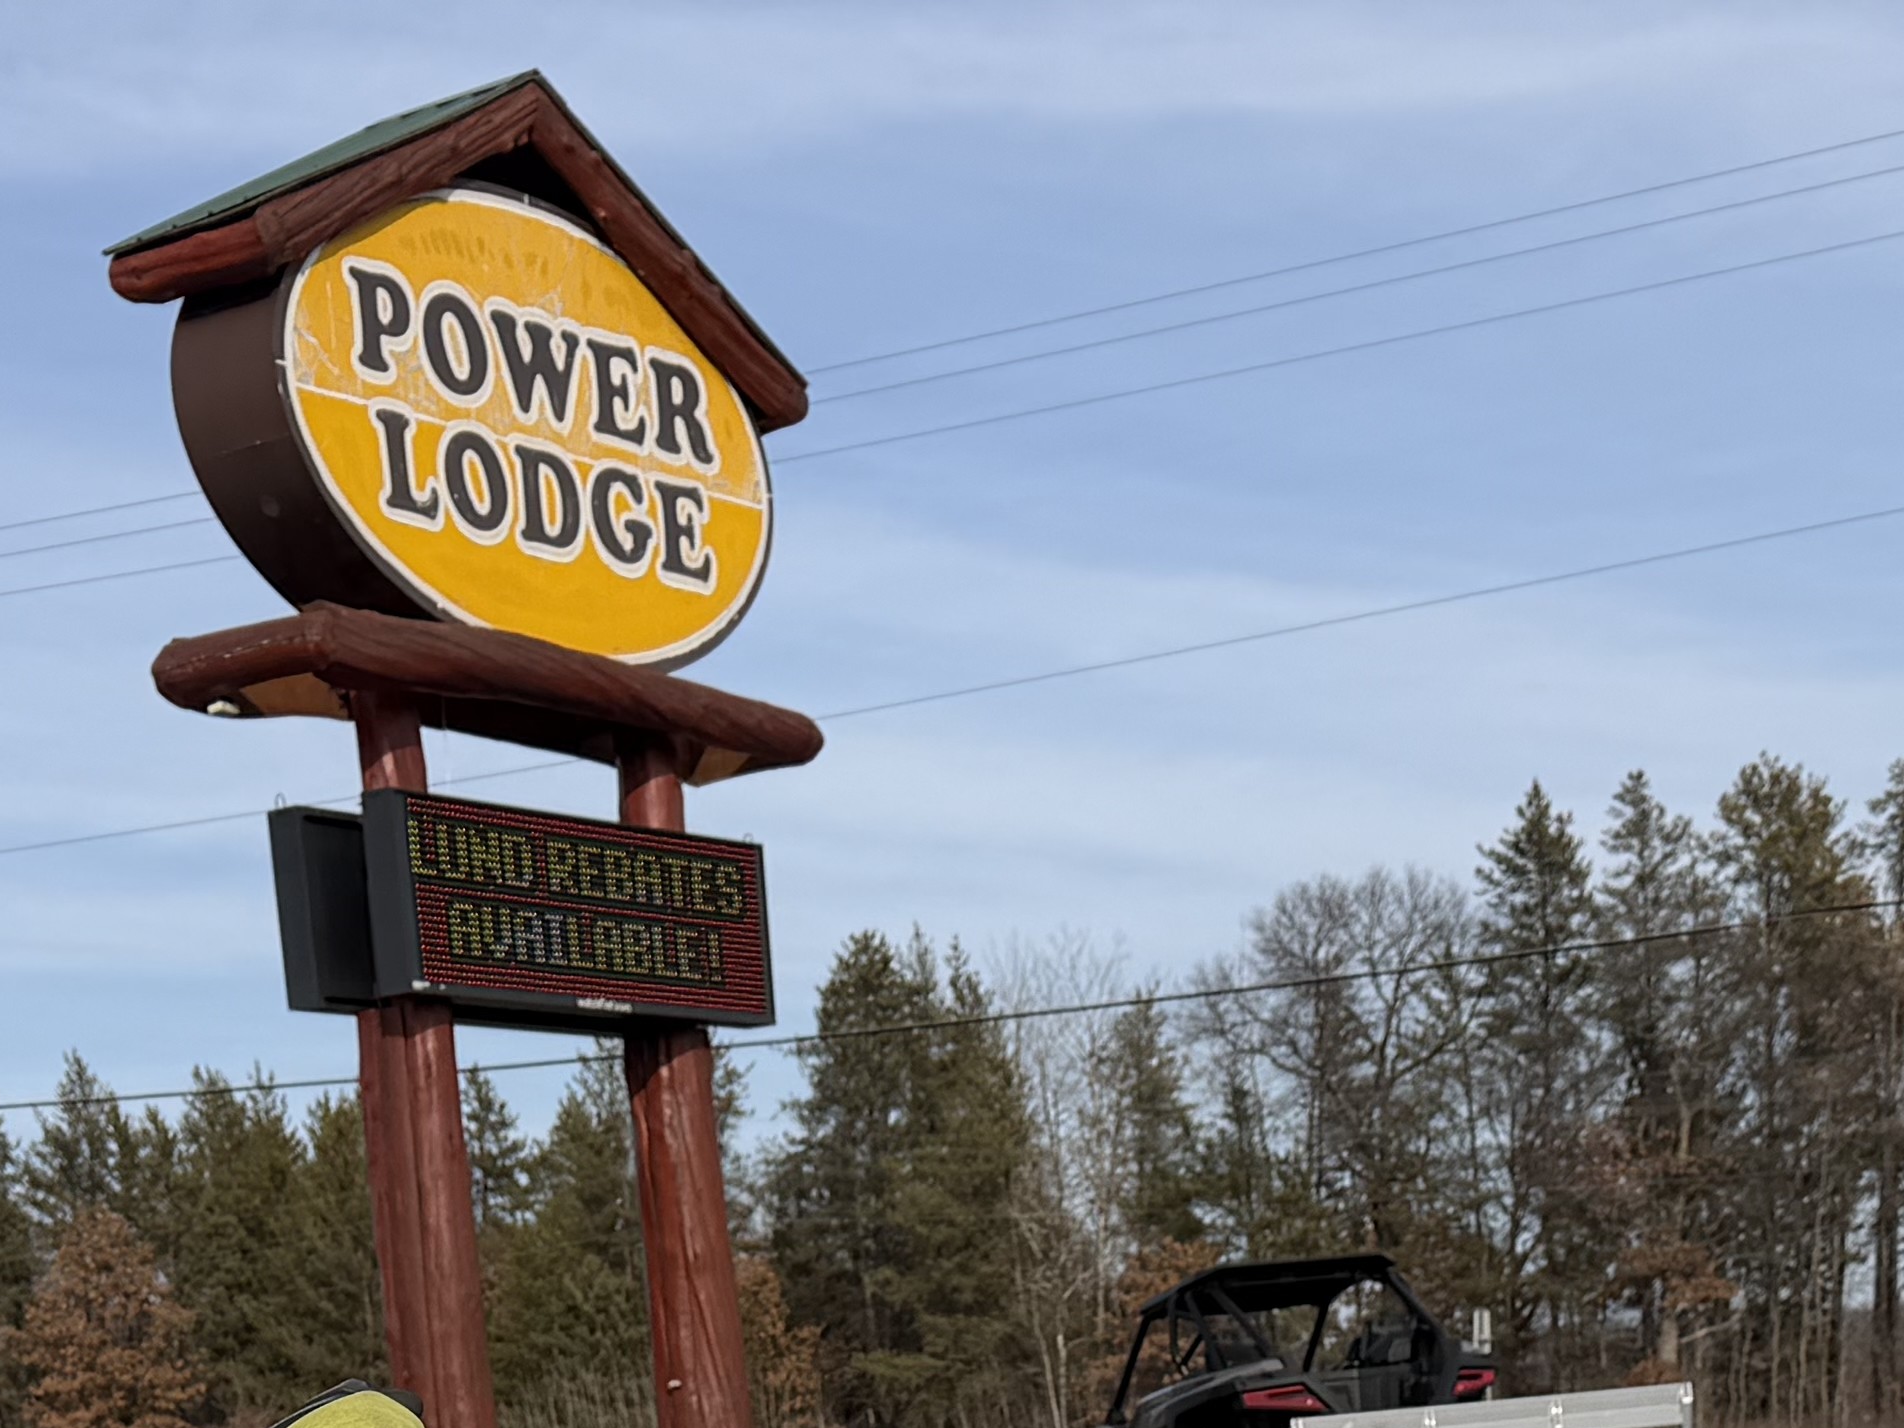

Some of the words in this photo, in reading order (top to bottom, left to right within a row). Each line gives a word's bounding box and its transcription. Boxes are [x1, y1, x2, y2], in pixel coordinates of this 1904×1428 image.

[344, 258, 717, 472] POWER
[370, 402, 715, 590] LODGE
[407, 818, 533, 888] LUND
[546, 840, 743, 916] REBATES
[449, 901, 723, 983] AVAILABLE!
